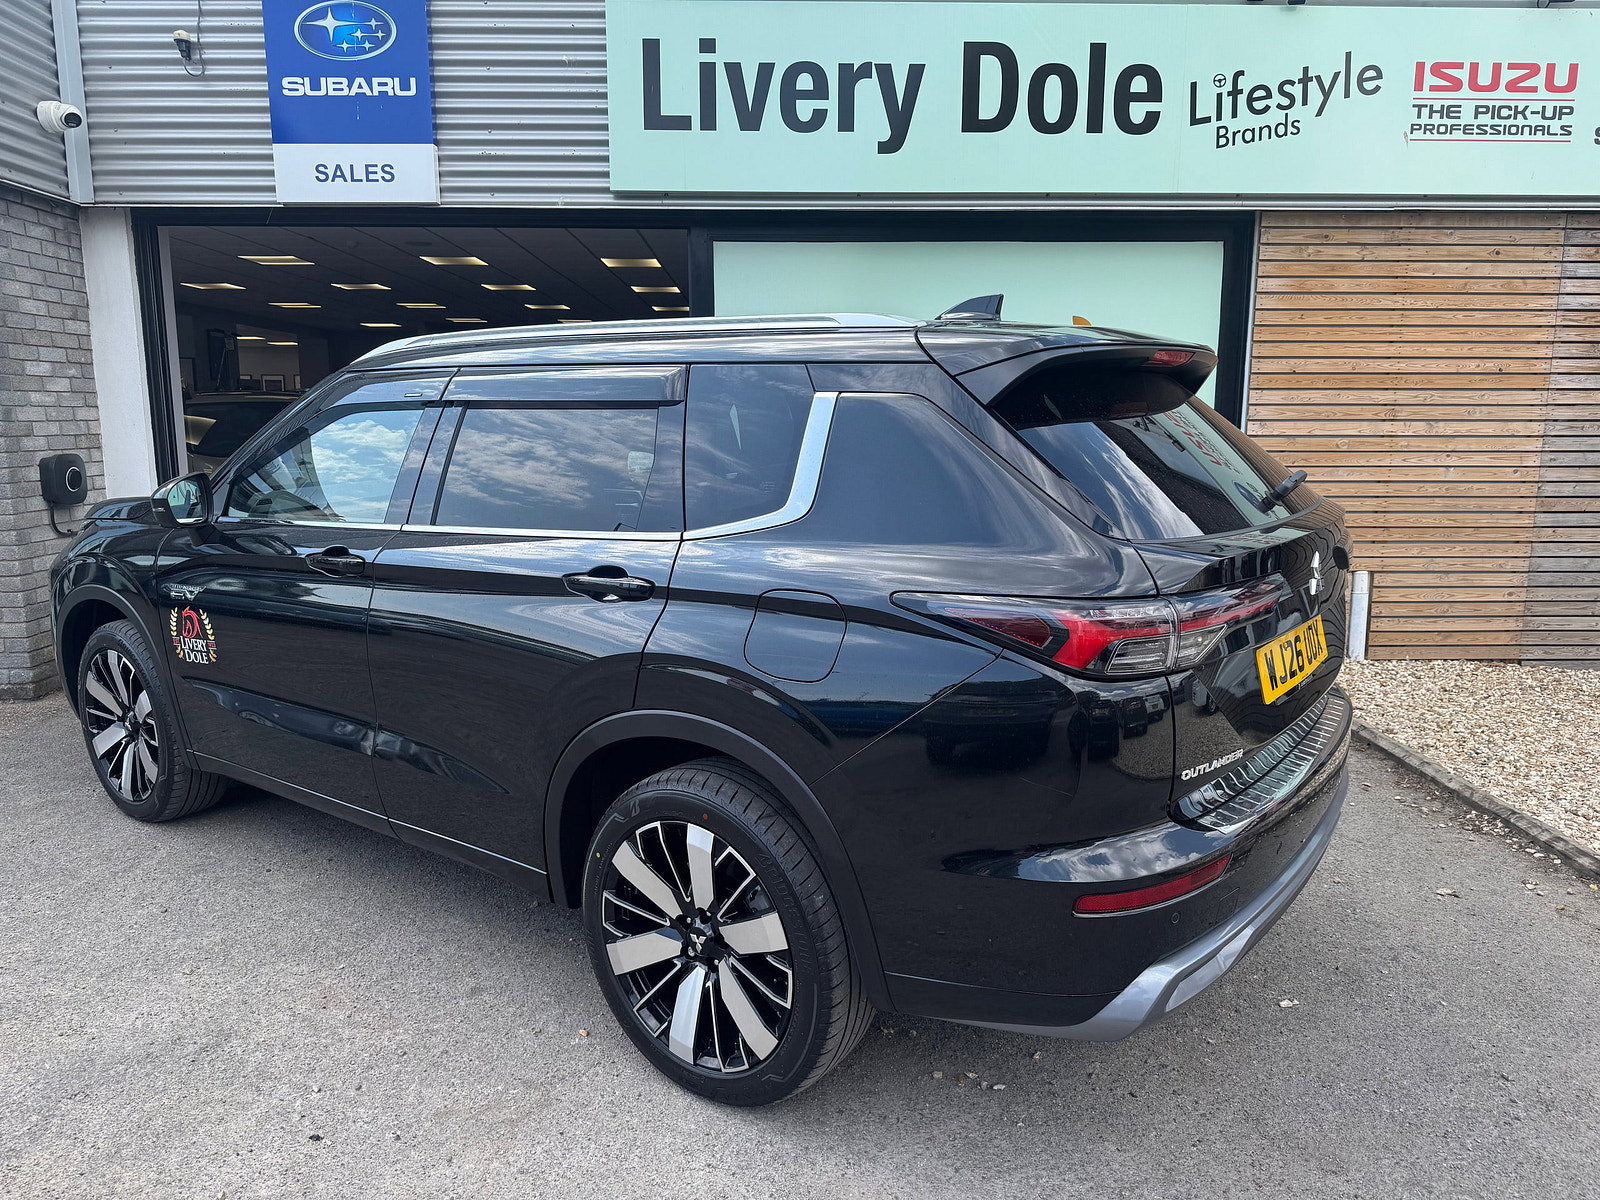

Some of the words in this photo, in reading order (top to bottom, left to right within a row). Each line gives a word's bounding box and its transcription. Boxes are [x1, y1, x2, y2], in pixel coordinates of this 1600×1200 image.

[281, 77, 417, 97] SUBARU
[1188, 51, 1384, 127] Lifestyle
[1412, 61, 1580, 94] ISUZU
[641, 37, 926, 155] Livery
[960, 40, 1163, 136] Dole
[1411, 103, 1462, 120] THE
[1472, 104, 1575, 121] PICK-UP
[1215, 112, 1301, 149] Brands
[1409, 123, 1573, 137] PROFESSIONALS
[314, 164, 396, 183] SALES
[180, 635, 208, 652] LIVERY
[184, 649, 209, 665] DOLE
[1264, 635, 1305, 691] WJ26
[1180, 748, 1244, 781] OUTLANDER
